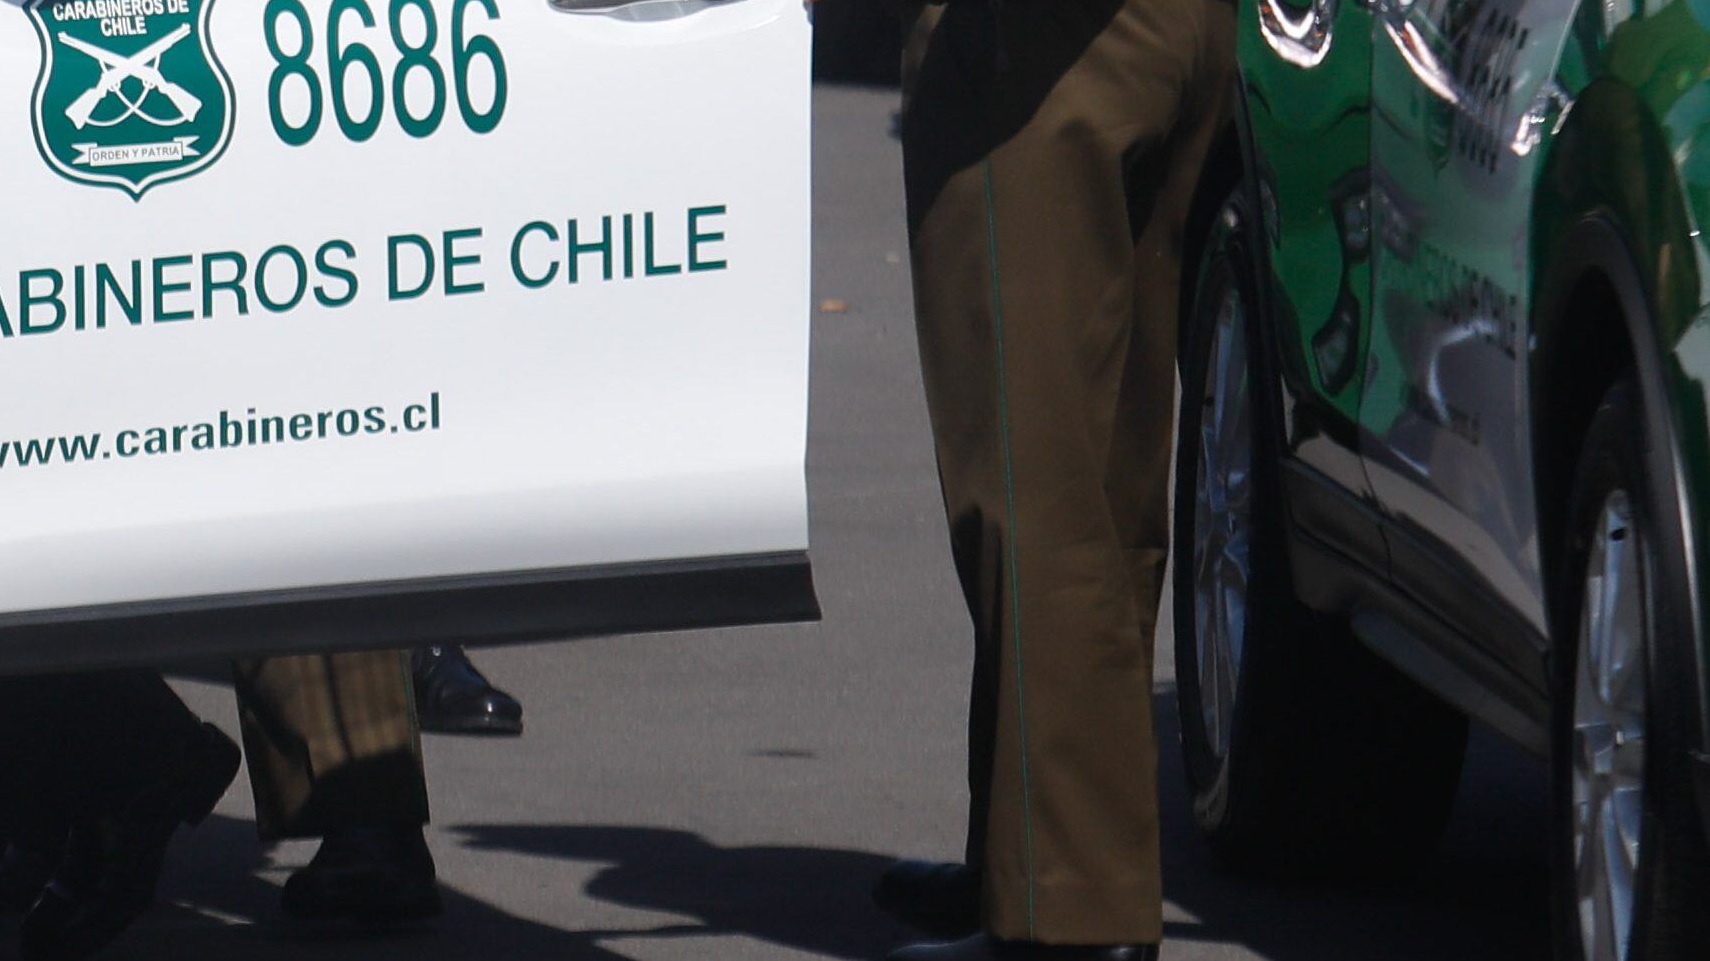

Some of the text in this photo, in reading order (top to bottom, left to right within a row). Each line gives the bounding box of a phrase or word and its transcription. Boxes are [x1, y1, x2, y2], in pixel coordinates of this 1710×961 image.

[100, 16, 148, 37] CHILE
[92, 146, 179, 162] ORDEN Y PATRIA
[387, 227, 486, 300] DE
[510, 205, 727, 289] CHILE
